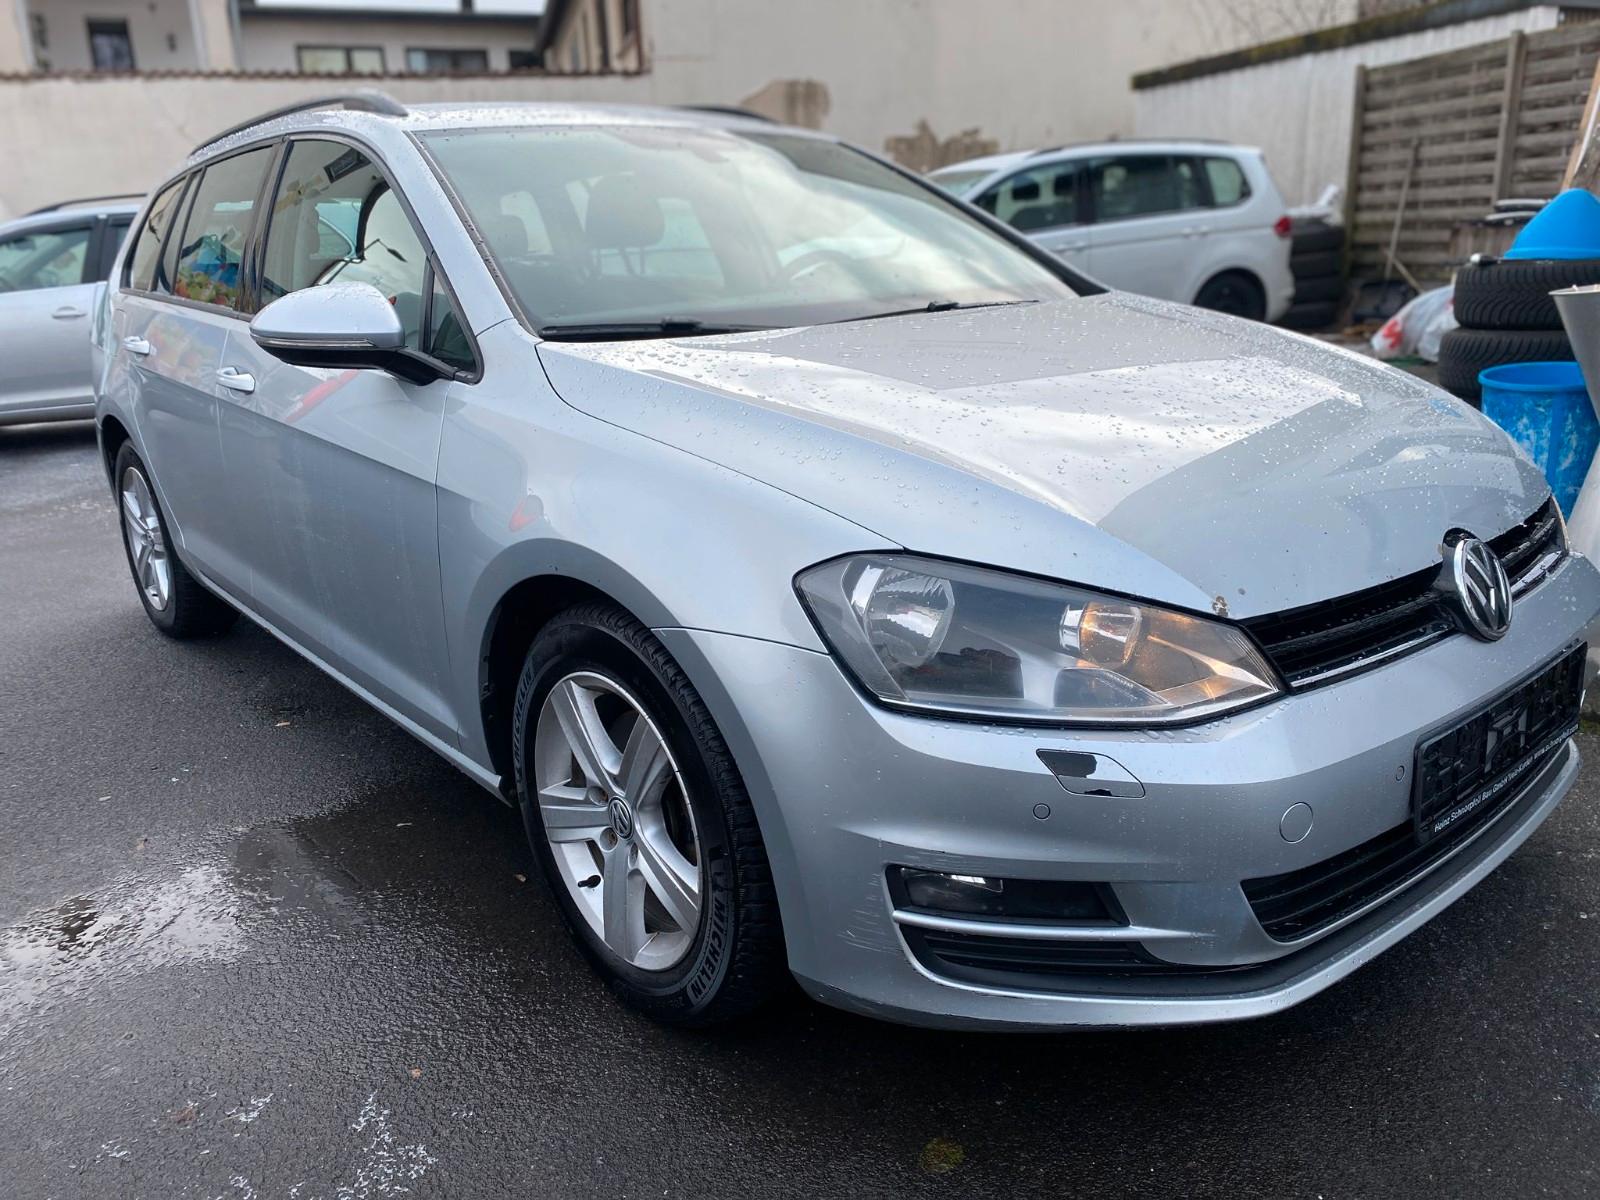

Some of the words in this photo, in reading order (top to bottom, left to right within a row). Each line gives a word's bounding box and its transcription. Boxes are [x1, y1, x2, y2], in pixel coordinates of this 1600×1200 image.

[1458, 541, 1510, 635] VW
[512, 665, 532, 763] MICHELIN
[690, 897, 728, 1000] MICHELIN
